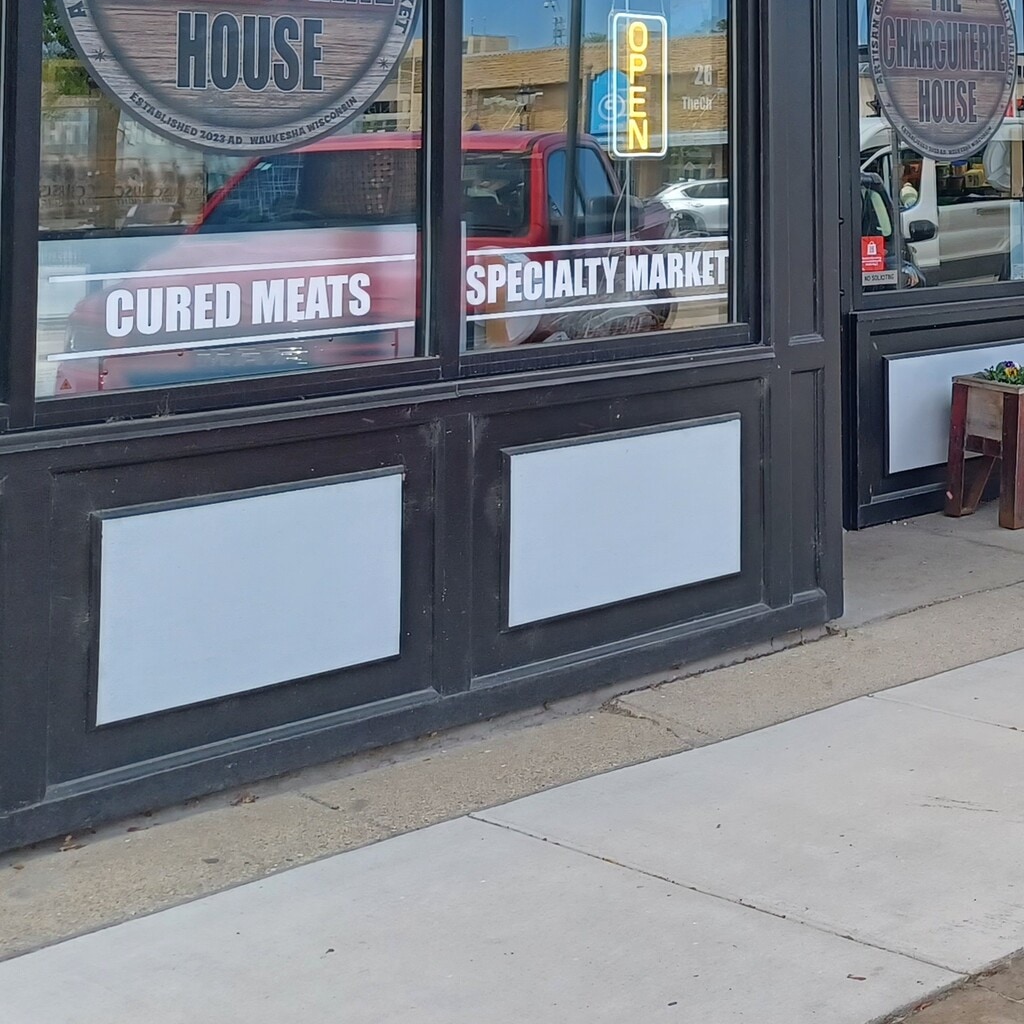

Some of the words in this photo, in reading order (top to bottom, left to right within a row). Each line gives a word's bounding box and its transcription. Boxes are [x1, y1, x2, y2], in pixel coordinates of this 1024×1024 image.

[175, 11, 324, 92] HOUSE
[871, 19, 885, 84] ARTISAN
[881, 16, 1008, 73] CHARCUTERIE
[628, 21, 649, 151] OPEN
[917, 78, 978, 125] HOUSE
[129, 91, 198, 138] ESTABLISHED
[200, 130, 227, 145] 2023
[249, 127, 306, 145] WAUKESHA
[105, 282, 242, 338] CURED
[251, 272, 372, 325] MEATS
[466, 255, 620, 306] SPECIALTY
[624, 249, 729, 292] MARKET
